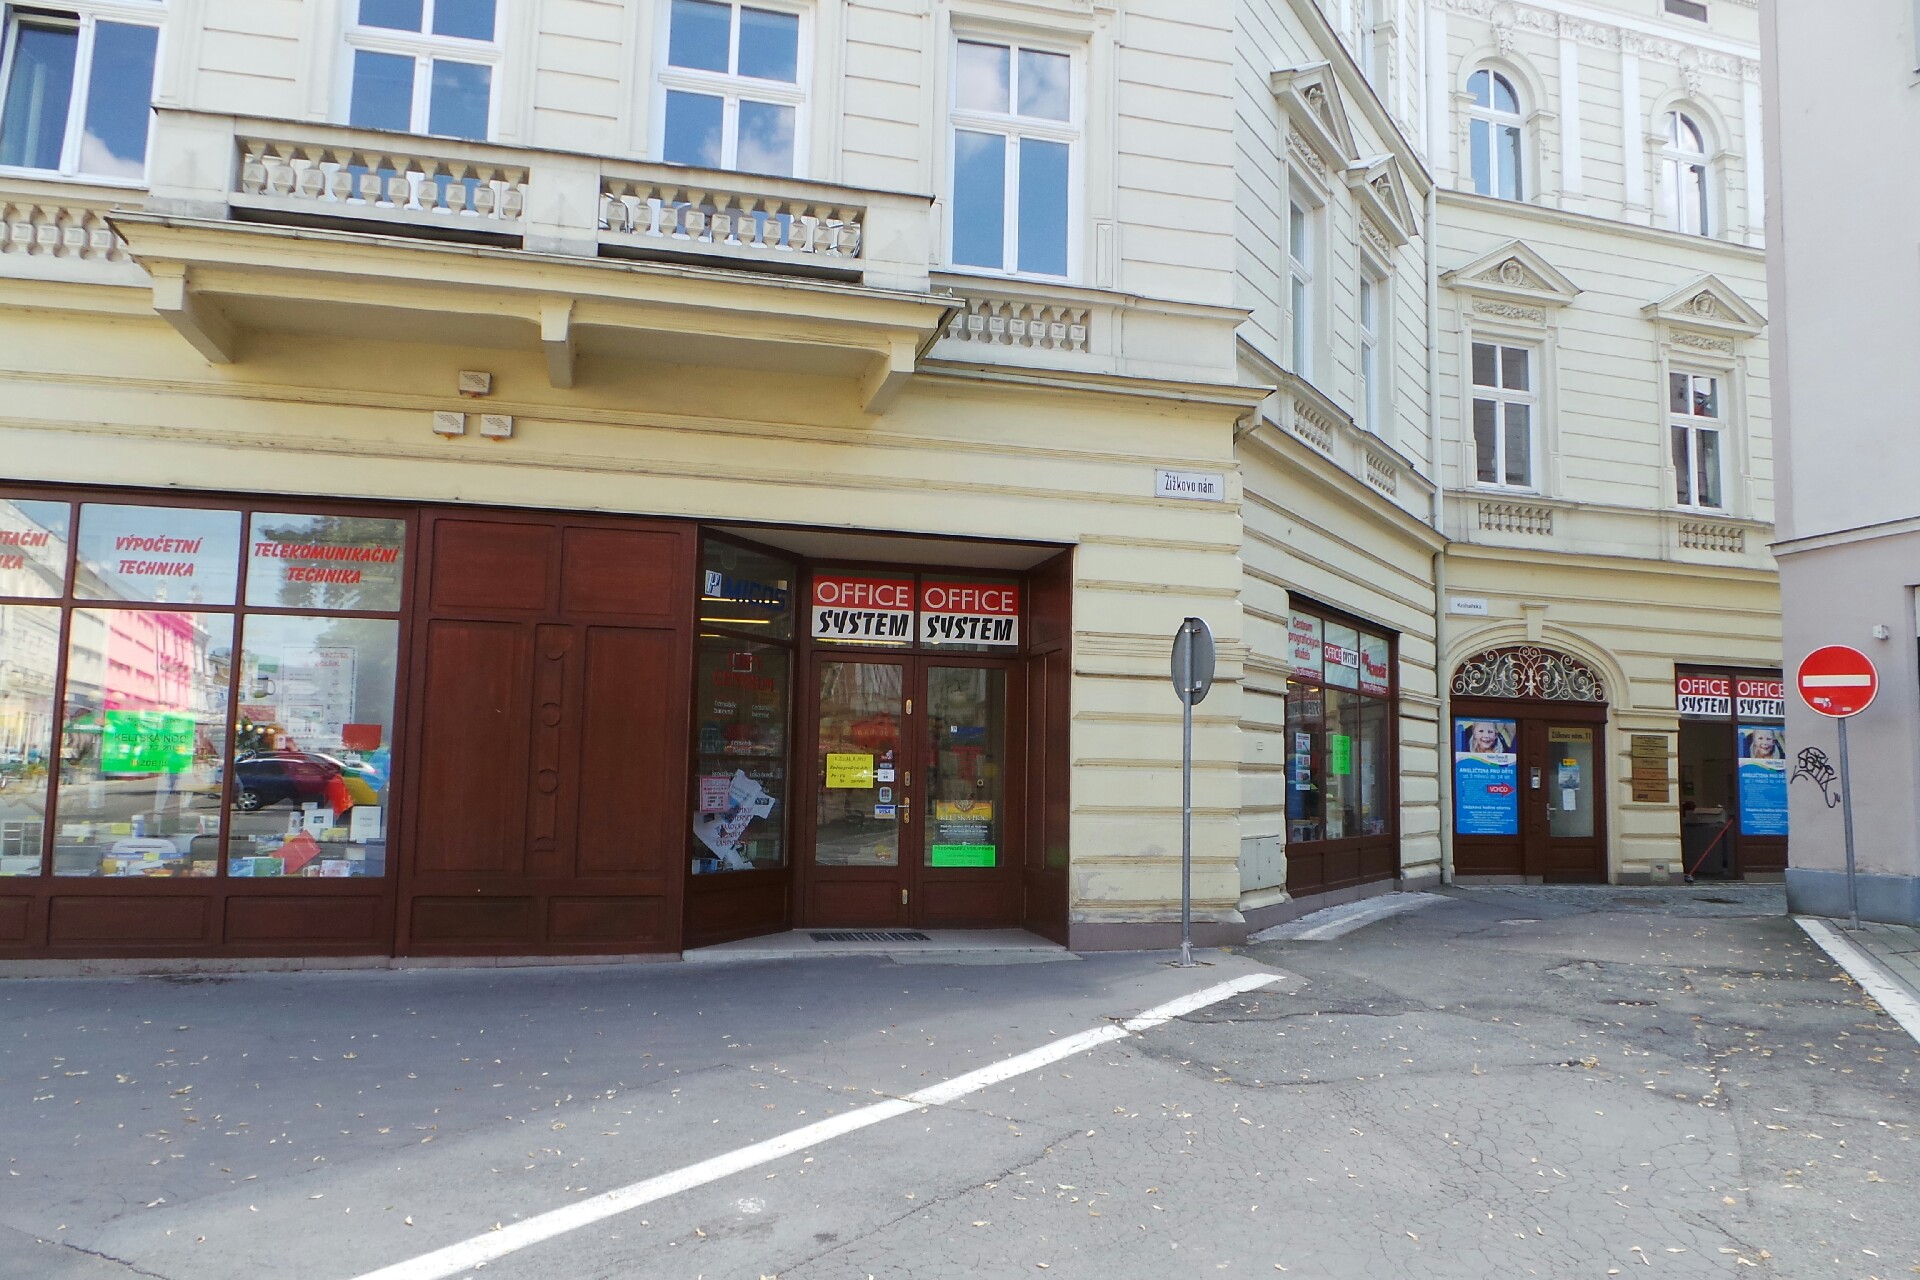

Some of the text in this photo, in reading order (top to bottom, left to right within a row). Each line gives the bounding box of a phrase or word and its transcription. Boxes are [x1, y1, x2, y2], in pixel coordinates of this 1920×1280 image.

[1165, 472, 1196, 492] Žižkovo
[0, 529, 50, 547] TAČNÍ
[116, 534, 203, 554] VÝPOČETNÍ
[254, 542, 400, 563] TELEKOMUNIKAČNÍ
[119, 560, 195, 577] TECHNIKA
[287, 567, 362, 584] TECHNIKA
[816, 581, 909, 607] OFFICE
[924, 587, 1014, 612] OFFICE
[818, 609, 910, 637] SYSTEM
[926, 615, 1014, 641] SYSTEM
[1293, 616, 1313, 632] Centrum
[1324, 646, 1341, 662] OFFICE
[1679, 679, 1729, 695] OFFICE
[1738, 681, 1784, 698] OFFICE
[1682, 697, 1728, 713] SYSTEM
[1740, 699, 1785, 715] SYSTEM
[115, 733, 187, 743] KELTSKÁ NOC
